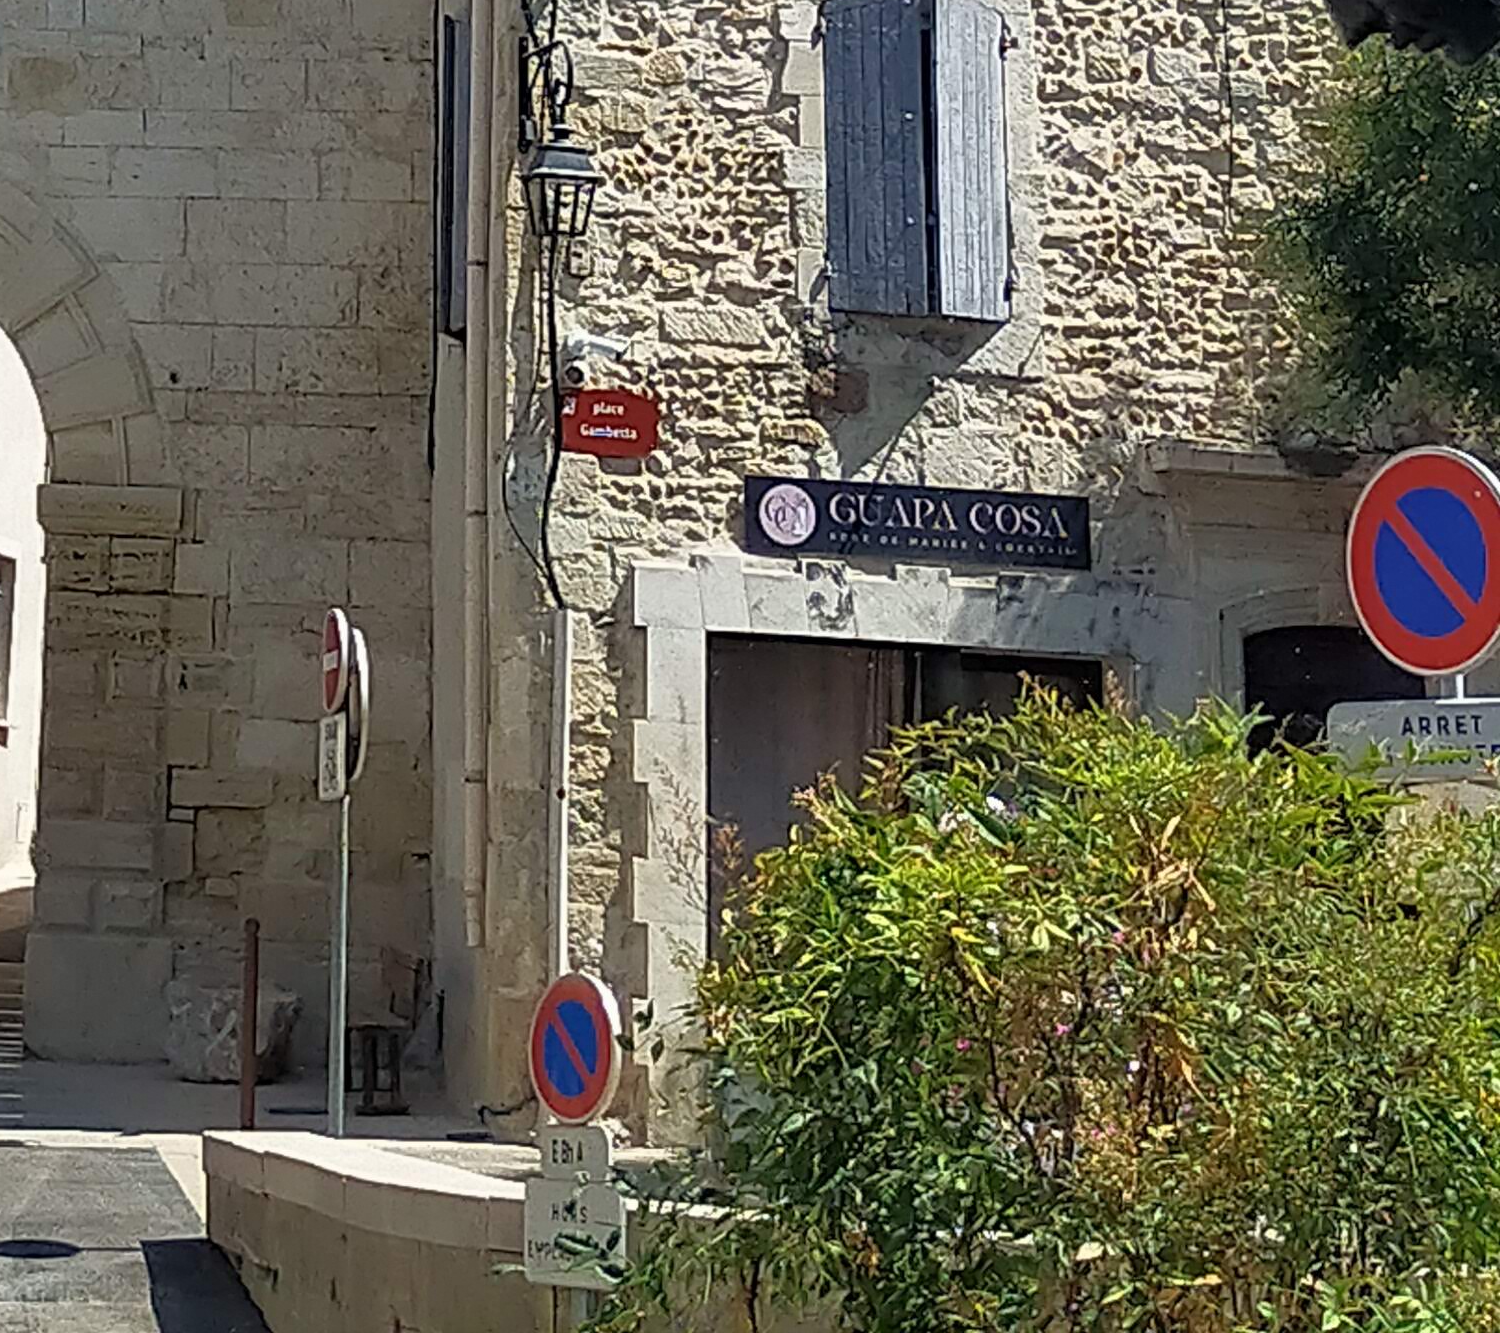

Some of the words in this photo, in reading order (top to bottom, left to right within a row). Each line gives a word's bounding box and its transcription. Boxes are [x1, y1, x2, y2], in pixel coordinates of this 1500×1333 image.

[593, 401, 624, 416] place
[829, 492, 958, 531] GUAPA
[969, 501, 1068, 539] COSA
[1401, 715, 1482, 736] ARRET
